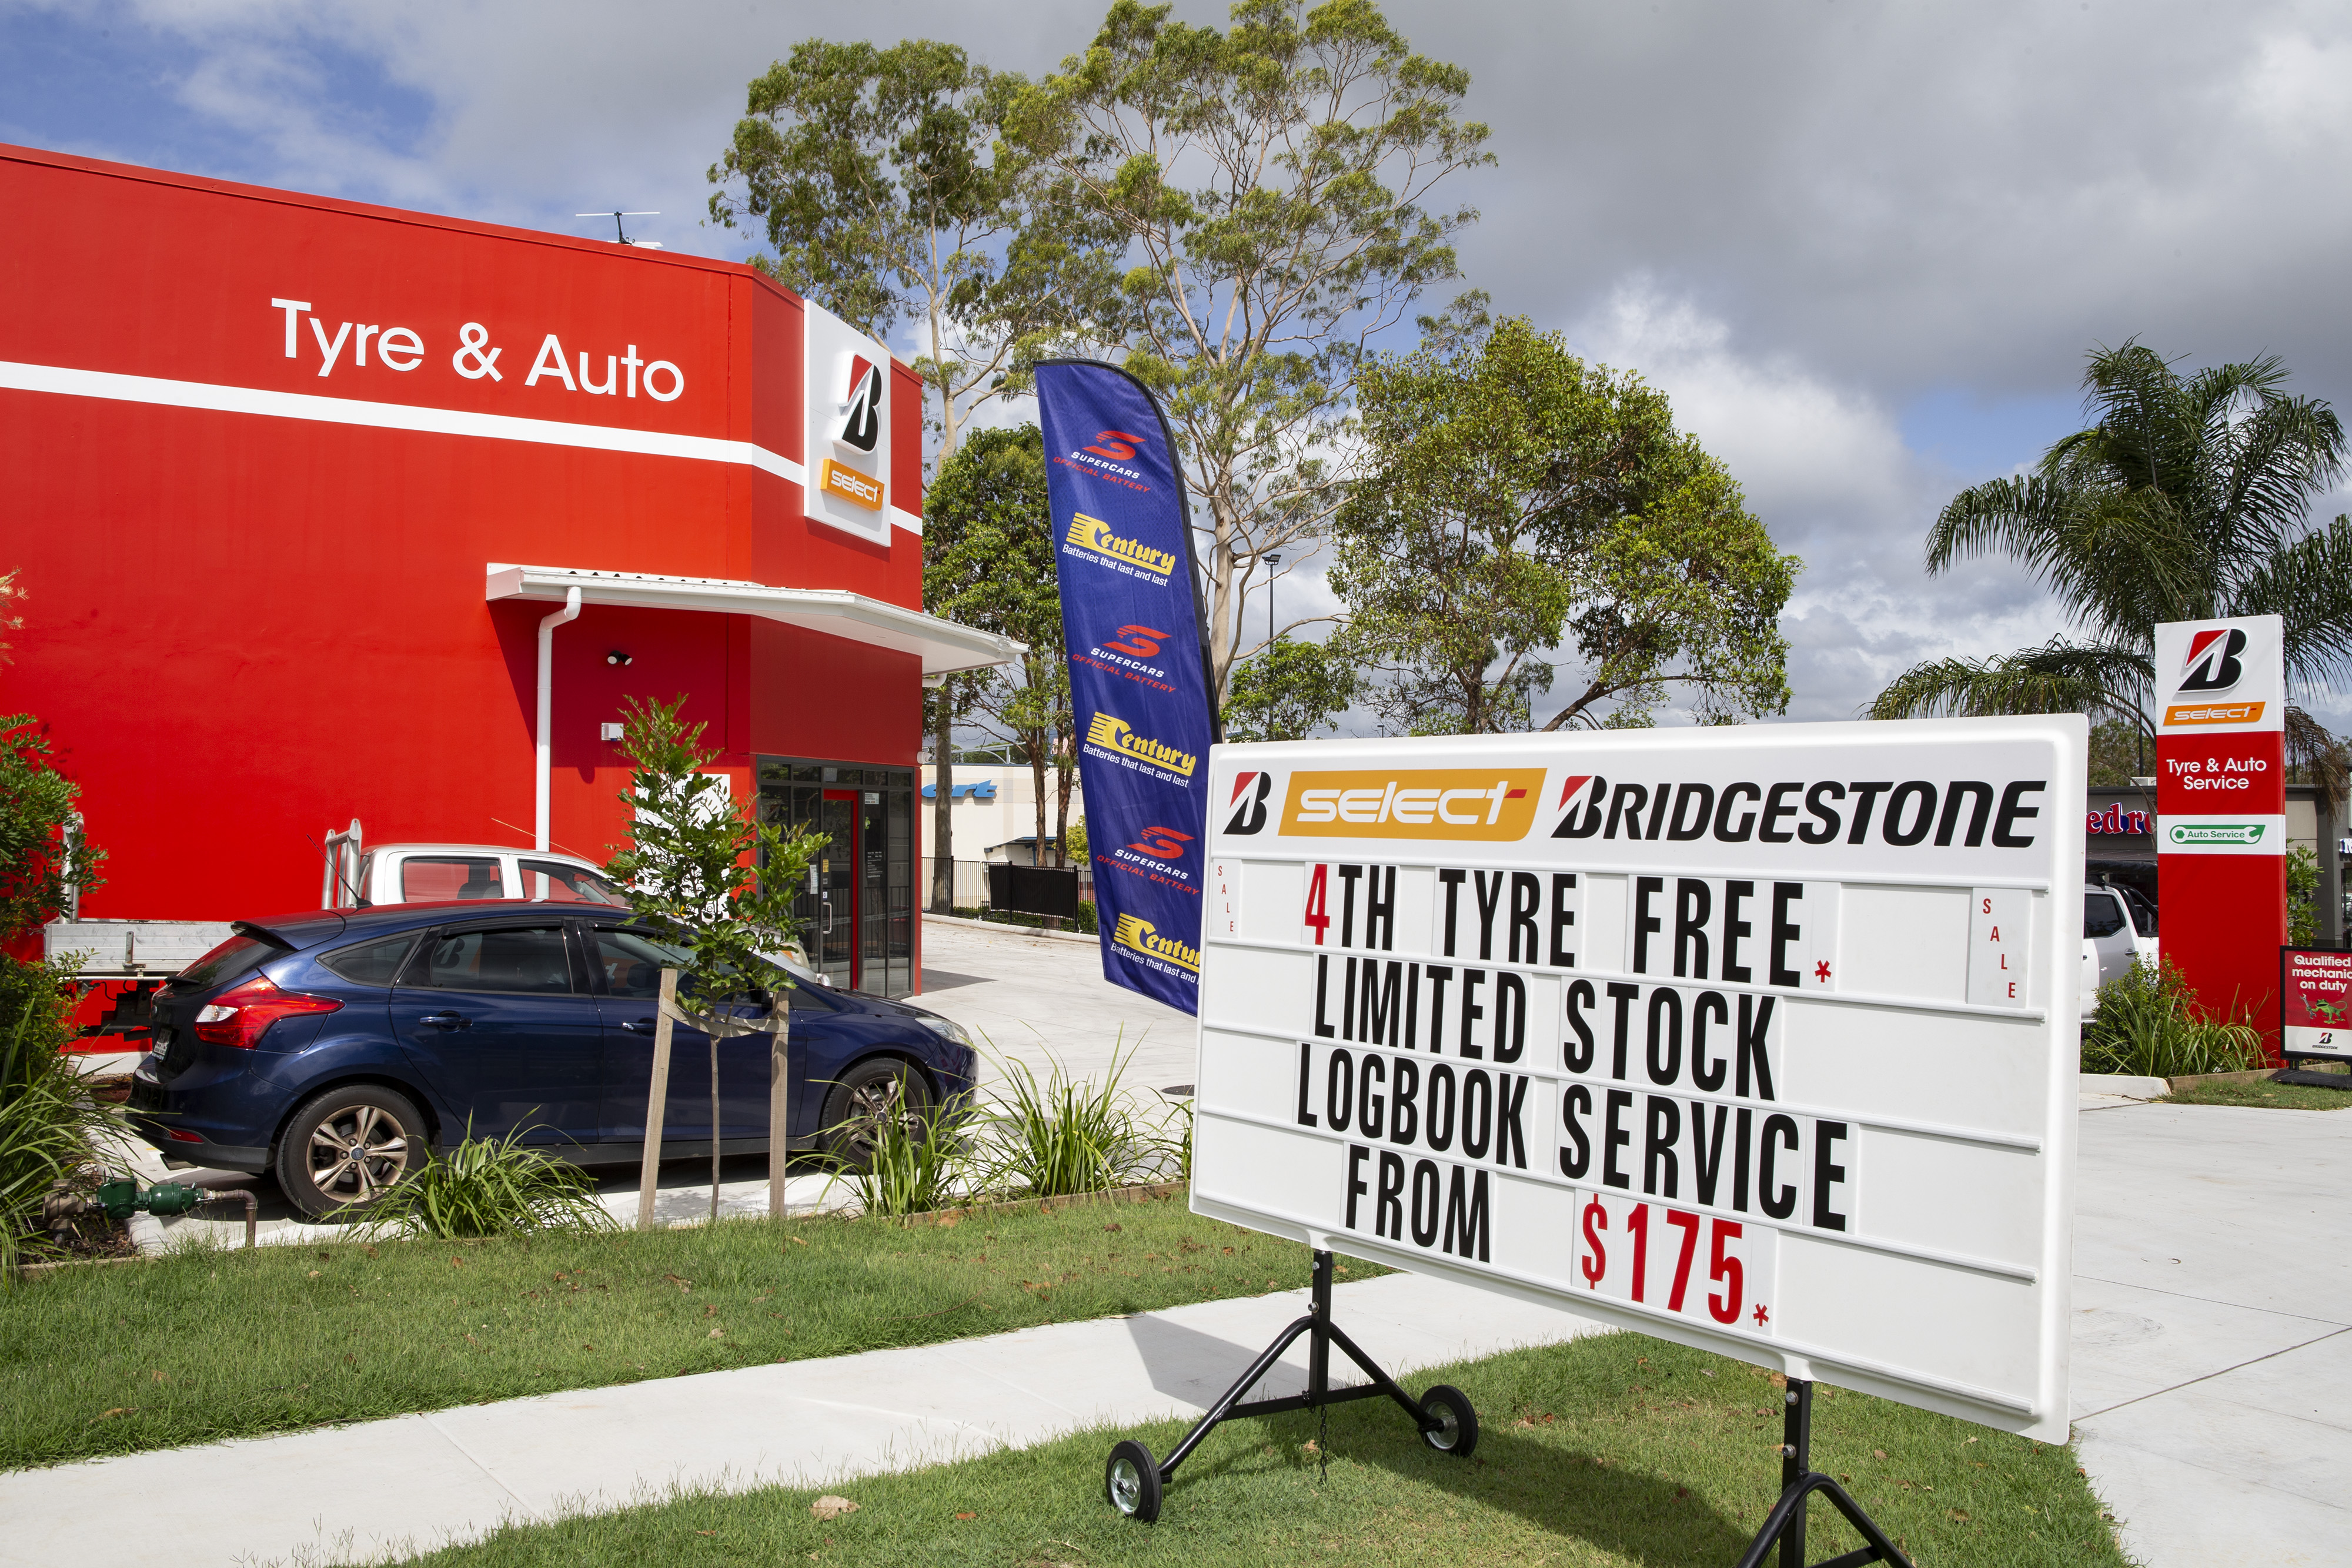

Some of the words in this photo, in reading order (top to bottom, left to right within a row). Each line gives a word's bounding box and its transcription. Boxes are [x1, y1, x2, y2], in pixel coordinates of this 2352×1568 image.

[272, 298, 425, 377] Tyre
[453, 322, 503, 382] &
[525, 334, 684, 402] Auto
[1053, 456, 1098, 477] OFFICIAL
[1102, 473, 1151, 493] BATTERY
[1071, 452, 1140, 479] SUPERCARS
[831, 470, 880, 503] select
[1065, 512, 1176, 576] Century
[1062, 543, 1098, 563] Batteries
[1100, 556, 1118, 570] that
[1117, 562, 1134, 576] last
[1134, 567, 1151, 581] and
[1151, 572, 1168, 587] last
[1072, 653, 1120, 676] OFFICIAL
[1124, 671, 1176, 693] BATTERY
[1091, 647, 1164, 677] SUPERCARS
[2173, 706, 2257, 721] select
[1086, 711, 1197, 777] Century
[1083, 744, 1120, 764] Batteries
[1121, 757, 1138, 770] that
[1139, 763, 1155, 776] last
[1155, 768, 1172, 782] and
[1172, 774, 1190, 788] last
[2166, 759, 2200, 776] Tyre
[2207, 758, 2220, 772] &
[2224, 757, 2267, 772] Auto
[2183, 776, 2249, 790] Service
[1297, 781, 1527, 825] select
[1551, 775, 2047, 848] BRIDGESTONE
[2086, 802, 2124, 835] ed
[2187, 830, 2209, 839] Auto
[2210, 830, 2245, 839] Service
[1097, 855, 1145, 877] OFFICIAL
[1150, 872, 1200, 895] BATTERY
[1115, 849, 1188, 880] SUPERCARS
[1305, 864, 1396, 951] 4TH
[1439, 868, 1576, 968] TYRE
[1110, 942, 1144, 964] Batteries
[1146, 957, 1163, 972] that
[1164, 963, 1179, 978] last
[1180, 969, 1196, 984] and
[2292, 968, 2352, 979] mechanic
[2294, 955, 2351, 967] Qualified
[2300, 981, 2316, 989] on
[2319, 980, 2347, 993] duty
[1314, 954, 1526, 1064] LIMITED
[1563, 979, 1776, 1101] STOCK
[1297, 1043, 1528, 1169] LOGBOOK
[1559, 1084, 1847, 1232] SERVICE
[1346, 1145, 1490, 1263] FROM
